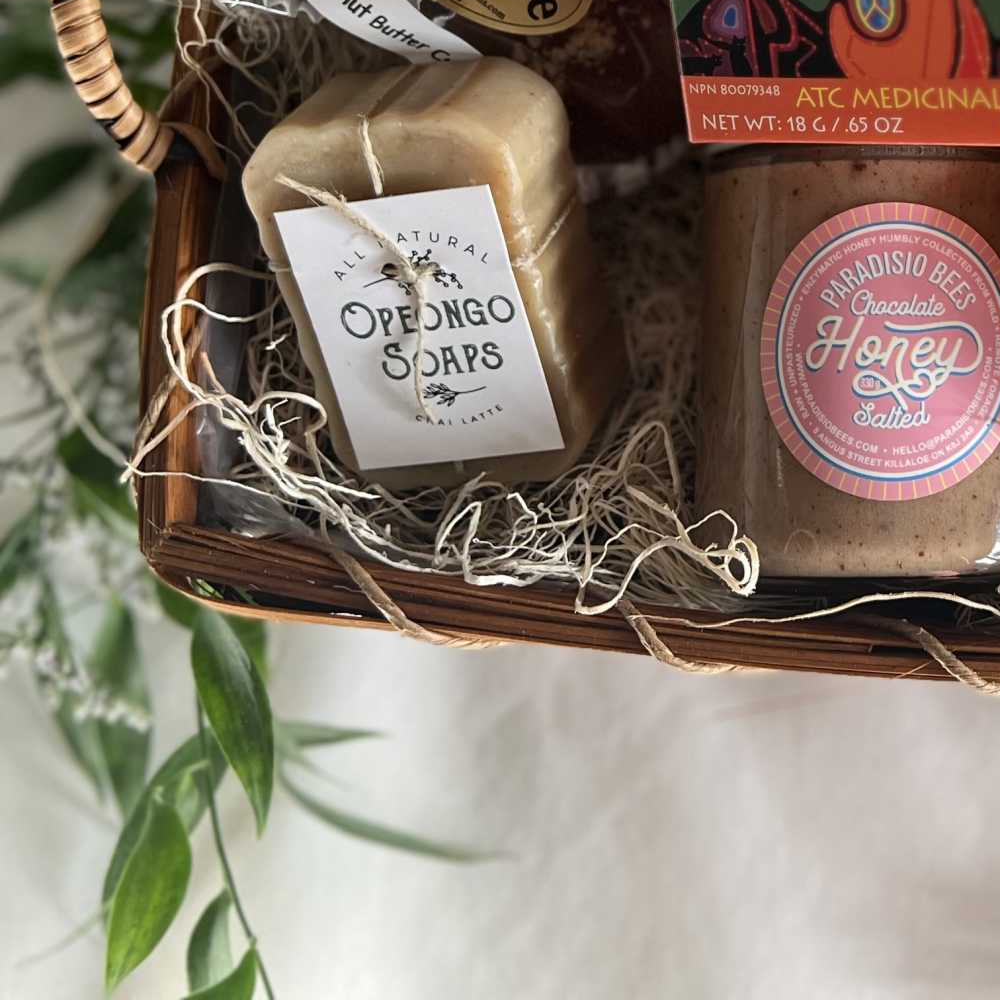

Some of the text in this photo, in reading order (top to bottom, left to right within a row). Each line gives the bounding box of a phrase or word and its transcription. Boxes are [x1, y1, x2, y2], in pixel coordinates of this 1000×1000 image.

[369, 15, 431, 51] Butter
[689, 84, 781, 96] NPN 80079348
[796, 87, 845, 109] ATC
[702, 114, 739, 131] NET
[743, 115, 783, 132] WT:
[786, 115, 807, 132] 18
[812, 117, 827, 133] G
[844, 117, 868, 134] .65
[874, 117, 905, 134] OZ
[333, 230, 490, 281] ALL ATURAL
[801, 250, 843, 295] ENZYMATIC
[843, 236, 877, 255] HONEY
[879, 231, 921, 244] HUMBLY
[922, 237, 973, 273] COLLECTED
[971, 271, 990, 297] FROM
[986, 296, 1000, 324] WILD
[820, 250, 977, 312] PARADISIO BEES
[850, 289, 946, 316] Chocolate
[805, 314, 984, 378] Honey
[381, 342, 504, 381] SOAPS
[461, 404, 504, 425] LATTE
[853, 401, 931, 430] Salted
[847, 450, 883, 467] STREET
[884, 455, 929, 468] KILLALOE
